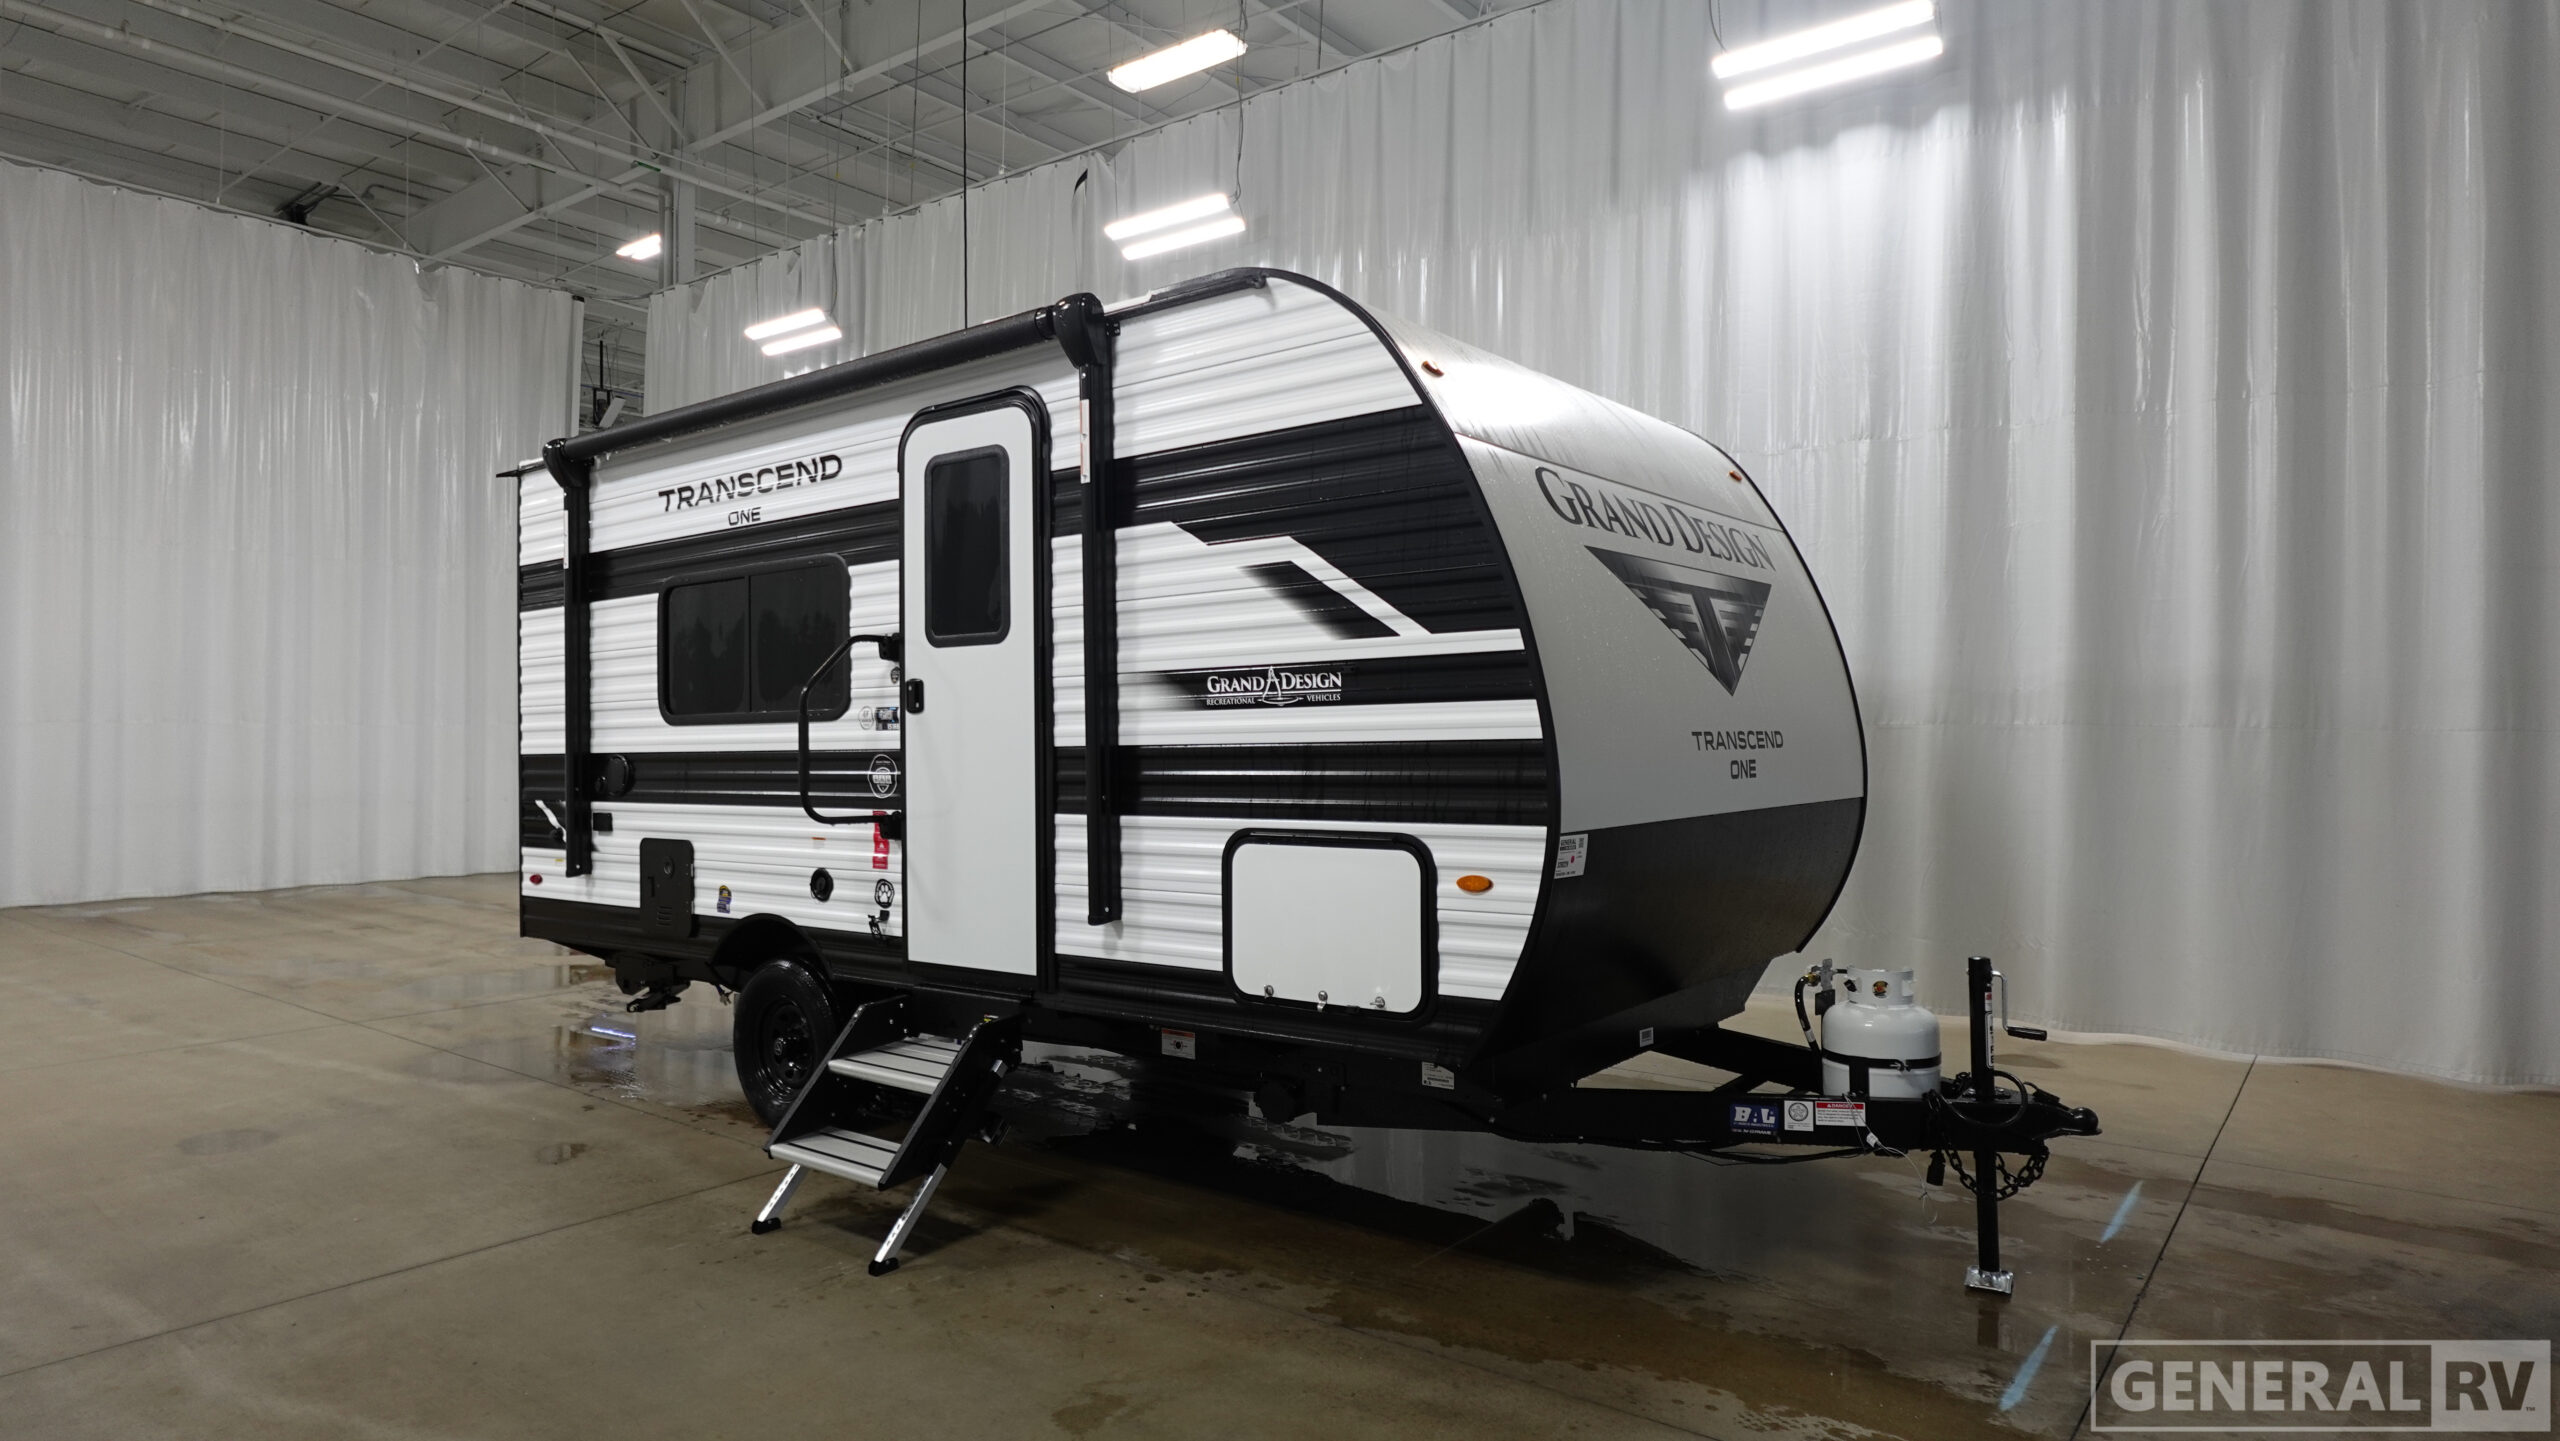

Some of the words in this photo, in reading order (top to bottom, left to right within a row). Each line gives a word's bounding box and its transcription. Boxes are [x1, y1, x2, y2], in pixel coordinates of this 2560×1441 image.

[658, 454, 842, 512] TRANSCEND
[728, 506, 762, 526] ONE
[1535, 466, 1674, 547] GRAND
[1661, 502, 1777, 572] DESIGN
[1207, 675, 1265, 693] GRAND
[1280, 672, 1342, 690] DESIGN
[1206, 697, 1256, 706] RECREATIONAL
[1306, 693, 1341, 702] VEHICLES
[1691, 730, 1784, 751] TRANSCEND
[1730, 759, 1757, 780] ONE
